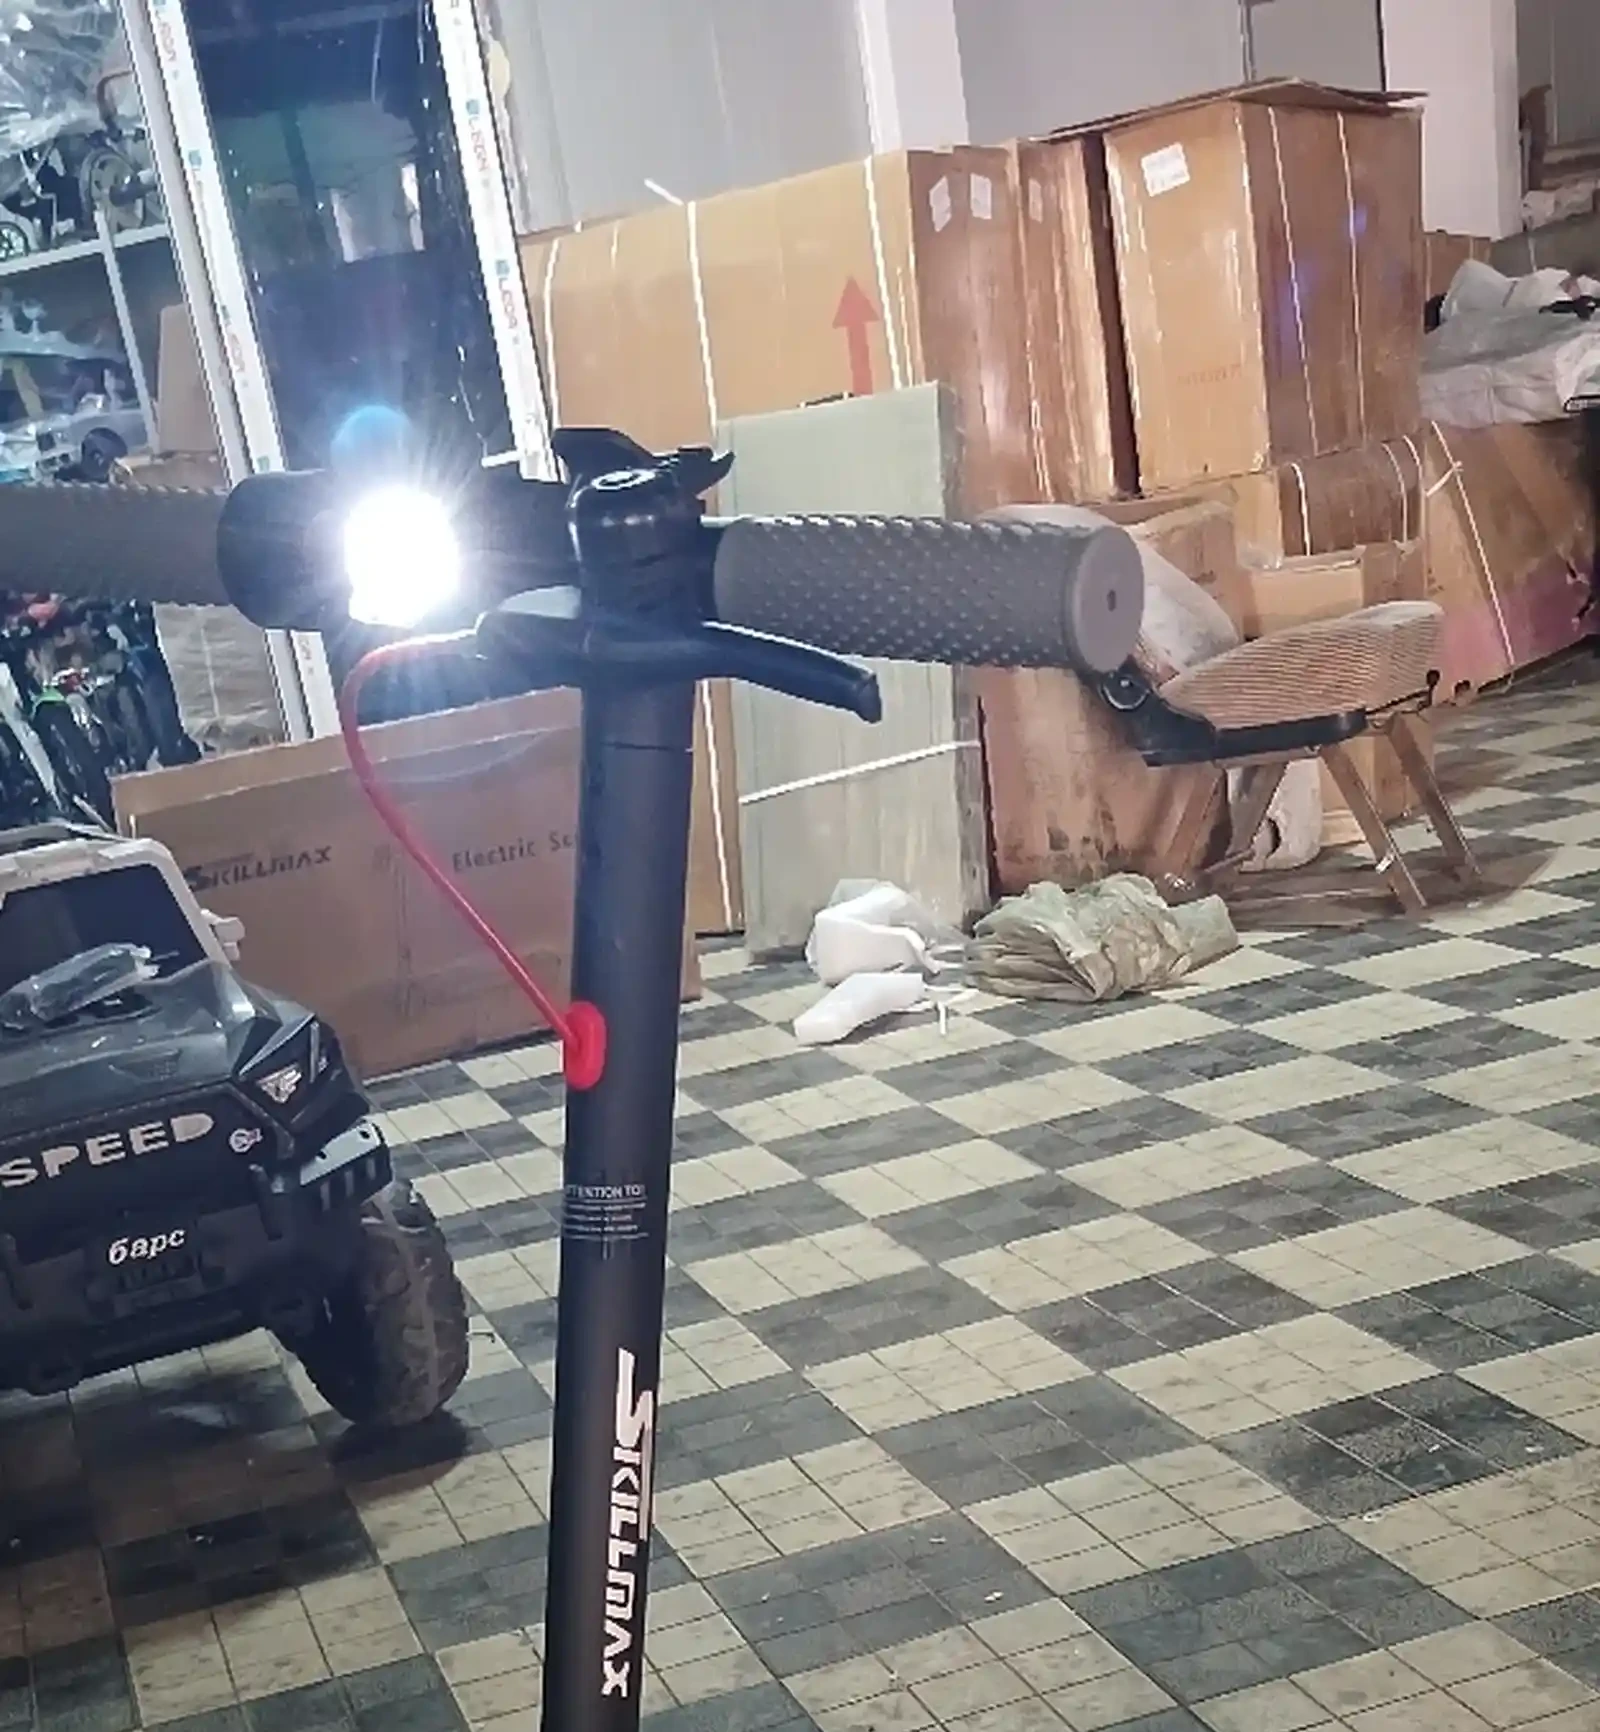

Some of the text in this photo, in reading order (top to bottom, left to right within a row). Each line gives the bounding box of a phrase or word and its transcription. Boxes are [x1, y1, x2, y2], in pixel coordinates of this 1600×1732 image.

[183, 846, 332, 891] SKILLMAX
[453, 837, 536, 873] Electric
[0, 1112, 214, 1187] SPEED
[108, 1228, 186, 1265] барс
[601, 1347, 654, 1698] SKILLMAX
